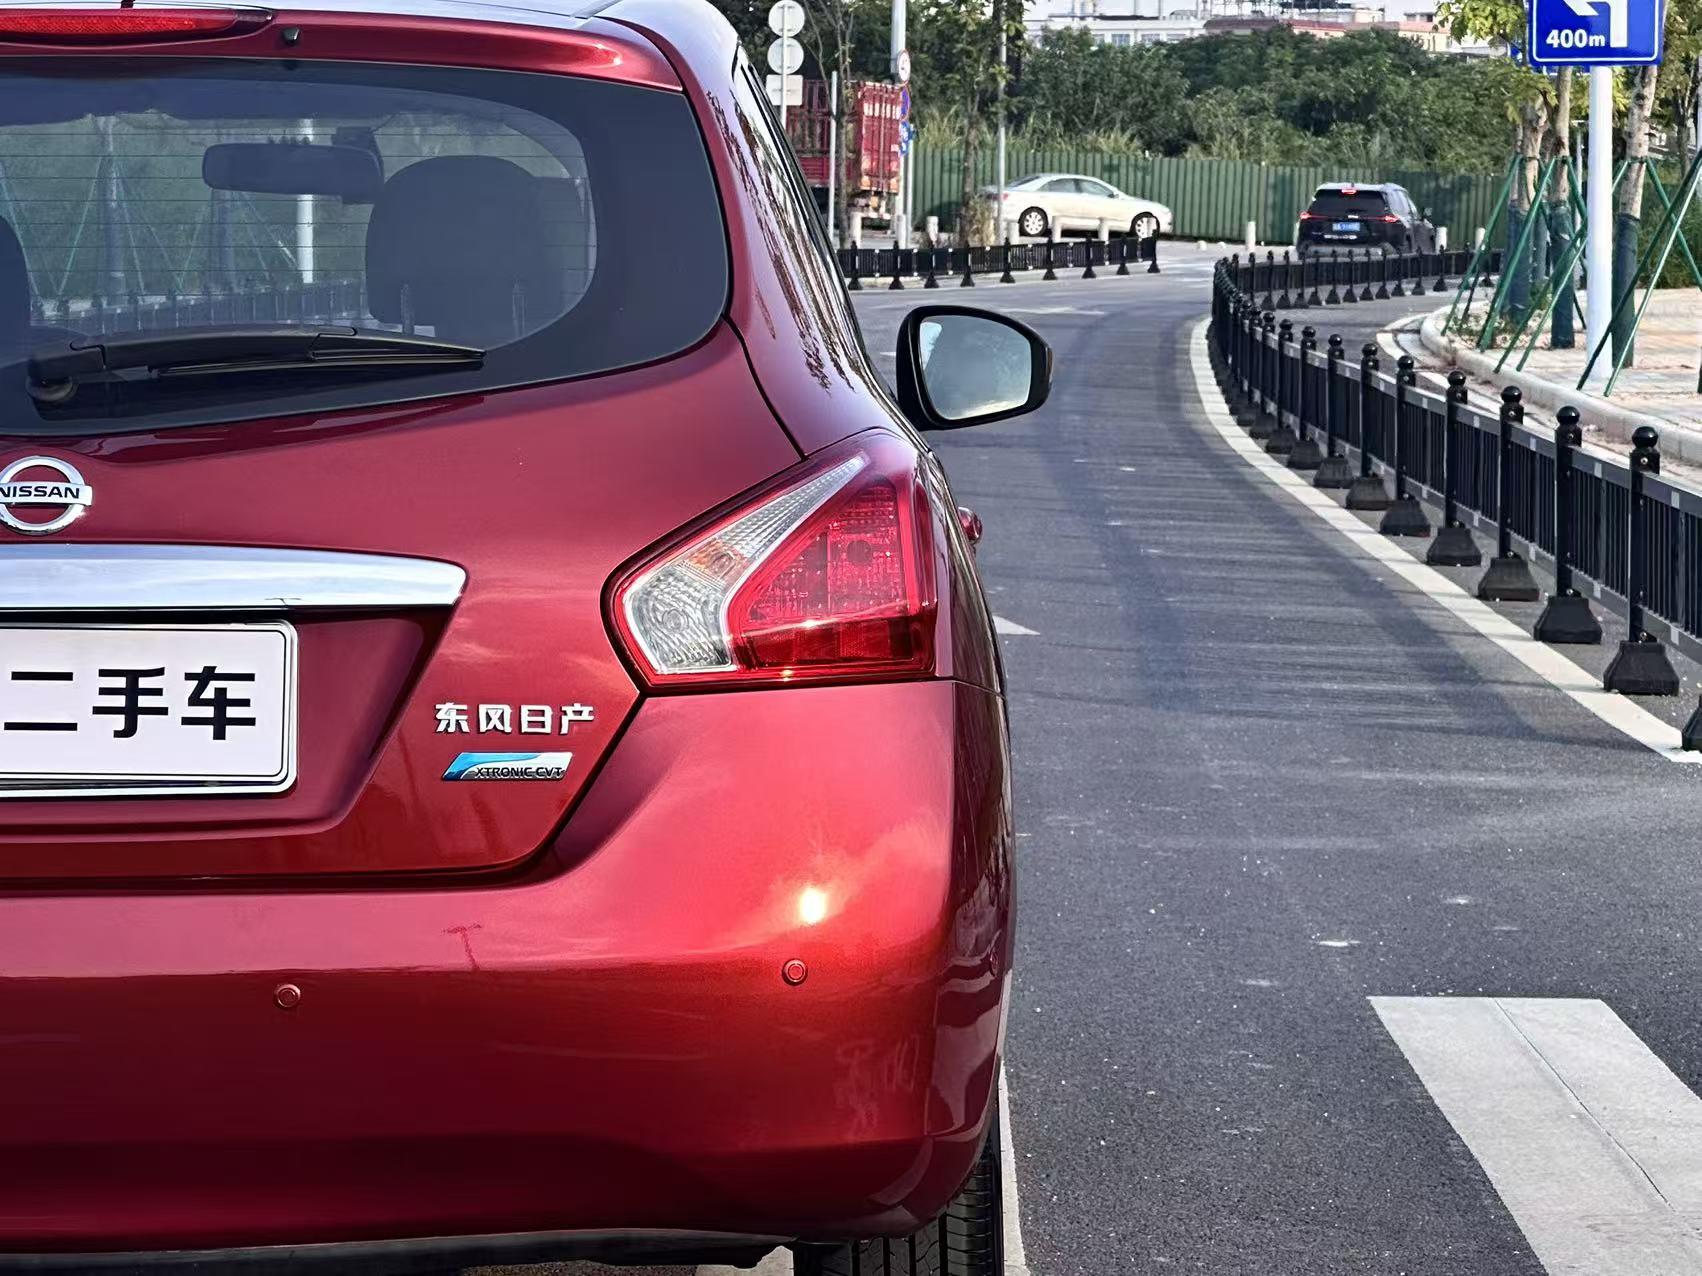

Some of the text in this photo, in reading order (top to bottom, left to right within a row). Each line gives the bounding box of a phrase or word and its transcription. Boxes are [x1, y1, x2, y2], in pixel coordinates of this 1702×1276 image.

[1546, 29, 1606, 48] 400m
[0, 485, 80, 499] NISSAN
[3, 665, 256, 740] 二手车
[434, 702, 595, 735] 东风日产
[475, 766, 563, 778] XTRONIC CVT
